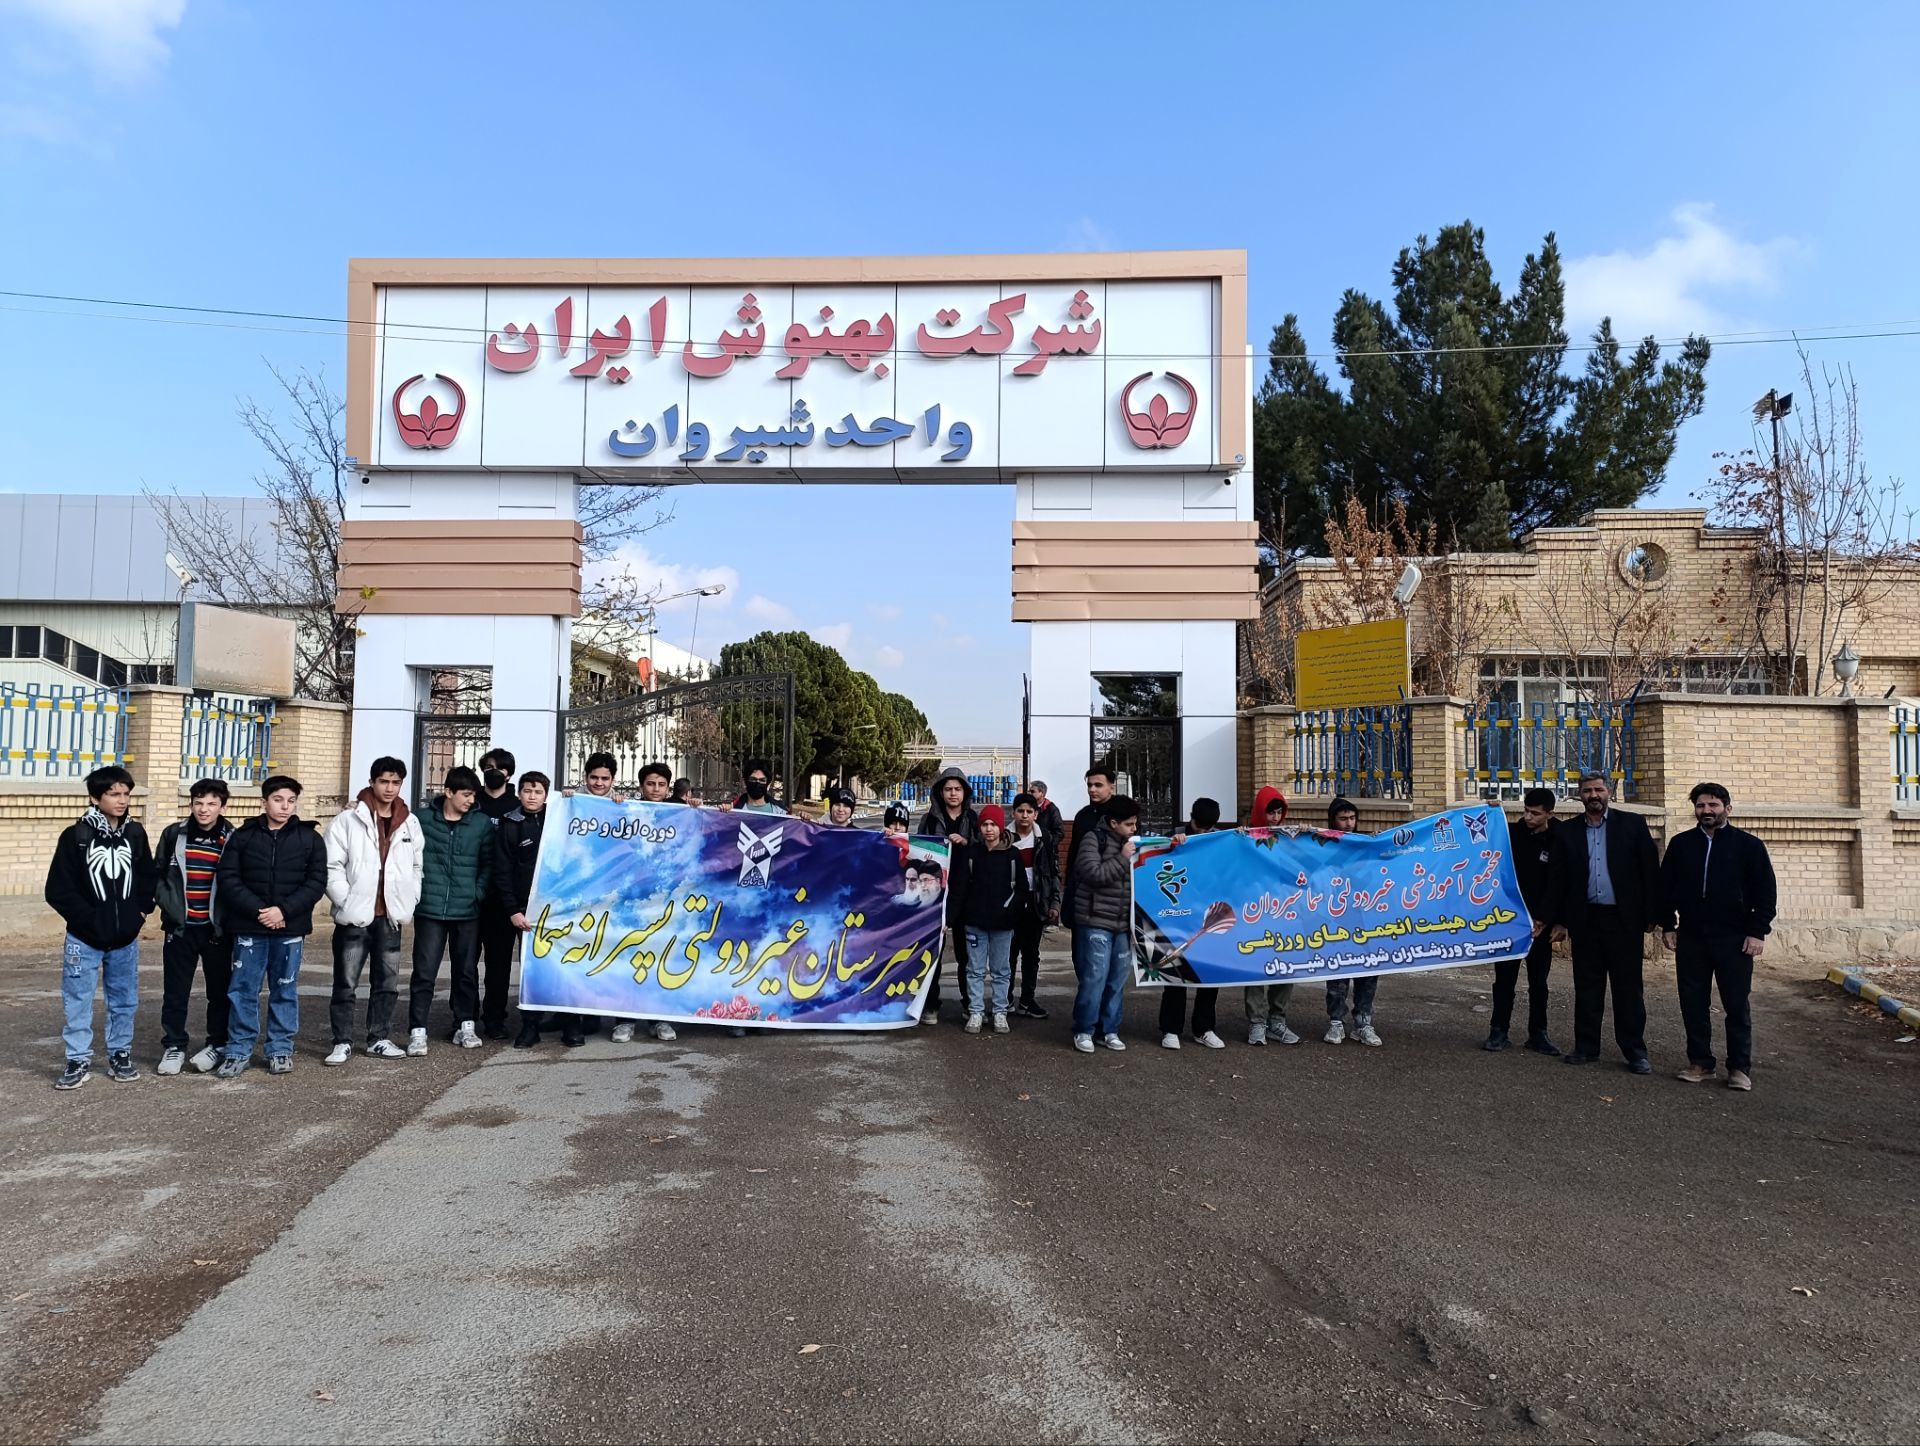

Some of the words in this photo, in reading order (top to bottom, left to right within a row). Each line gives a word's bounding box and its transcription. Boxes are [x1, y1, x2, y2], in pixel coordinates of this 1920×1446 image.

[486, 295, 668, 384] ایران
[681, 292, 895, 380] بهنوش
[916, 289, 1102, 376] شرکت
[608, 398, 815, 464] شیروان
[824, 402, 974, 462] واحد
[568, 816, 599, 836] دوم
[598, 821, 611, 838] و
[611, 816, 640, 841] اول
[640, 823, 677, 843] دوره
[1401, 857, 1470, 910] آموزشی
[1469, 849, 1502, 906] مجتمع
[1242, 871, 1308, 924] شیروان
[1306, 886, 1324, 912] سما
[533, 903, 574, 958] سما
[1352, 915, 1413, 944] انجمن
[1414, 914, 1467, 936] هیئت
[1468, 905, 1517, 933] حامی
[561, 900, 675, 985] پسرانه
[787, 911, 934, 1000] دبیرستان
[1237, 929, 1306, 954] ورزشی
[1390, 942, 1463, 964] ورزشکاران
[1463, 936, 1513, 956] بسیج
[1264, 953, 1326, 976] شیروان
[1326, 947, 1390, 971] شهرستان
